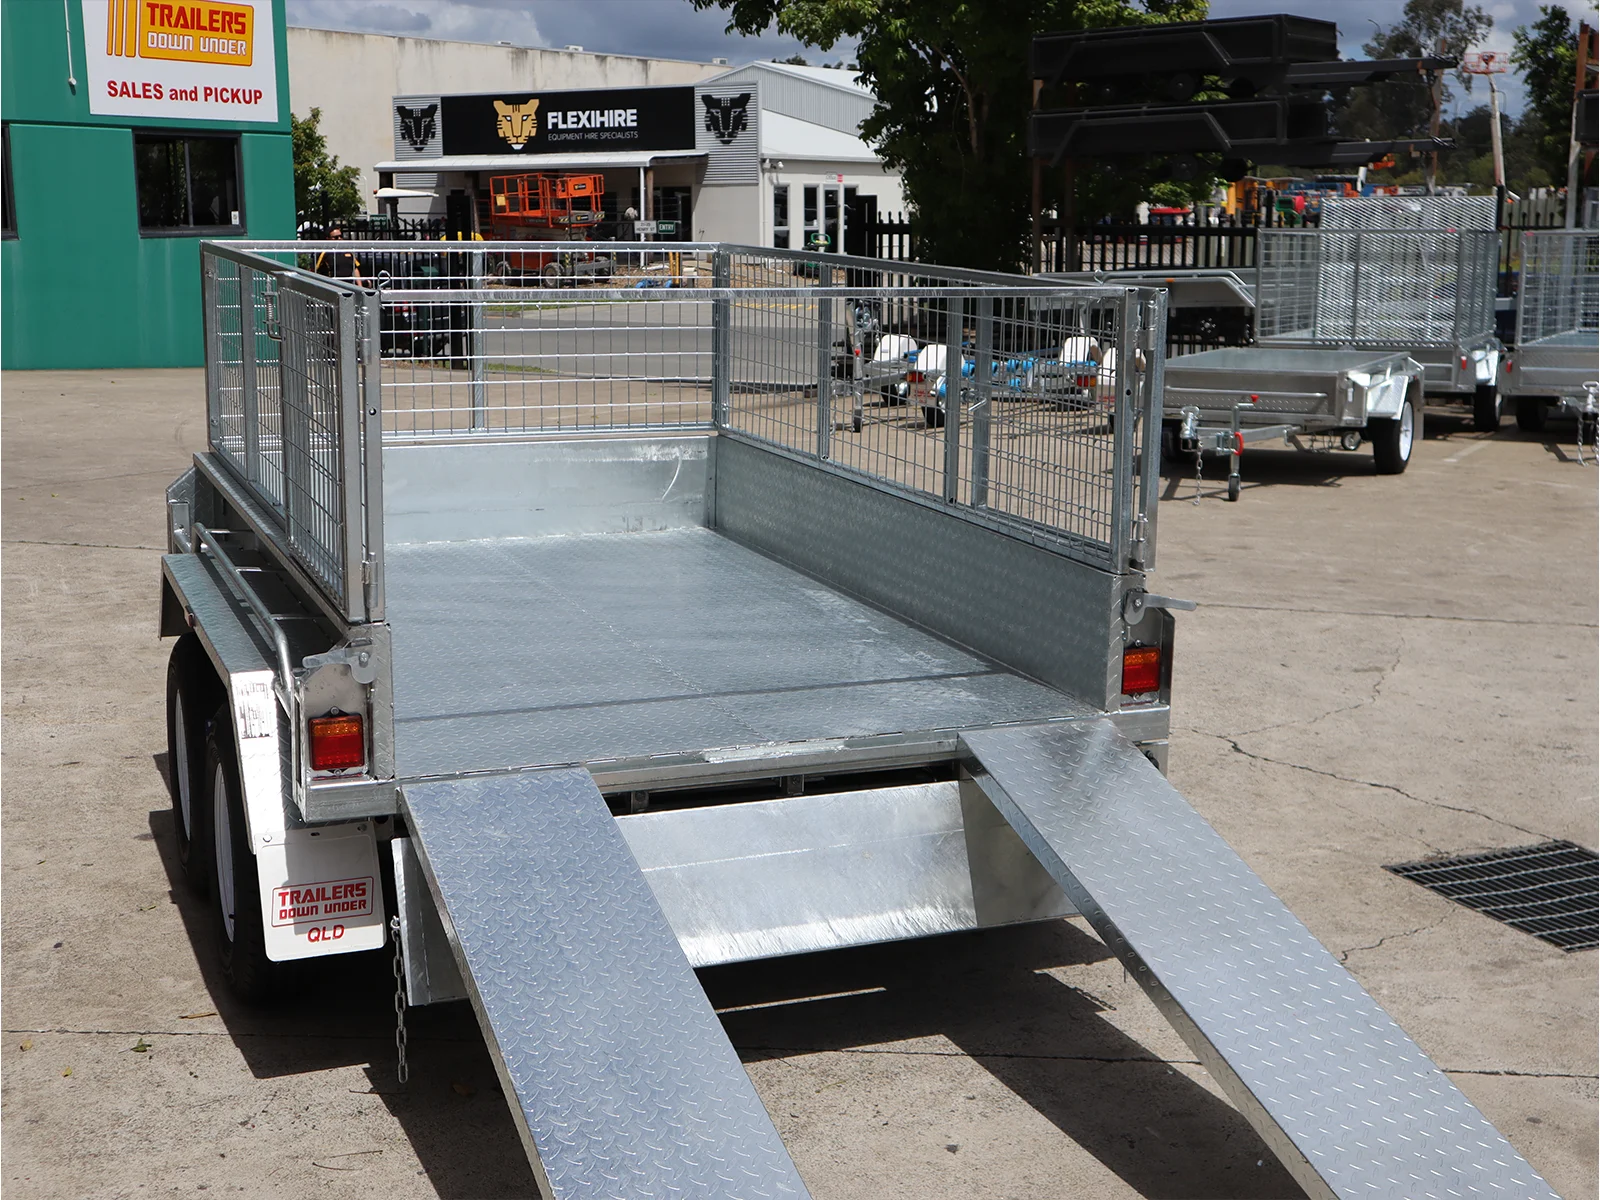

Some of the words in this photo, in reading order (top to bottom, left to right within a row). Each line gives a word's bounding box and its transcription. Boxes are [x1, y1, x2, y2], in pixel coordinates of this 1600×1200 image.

[146, 2, 247, 35] TRAILERS
[147, 31, 194, 51] DOWN
[200, 36, 247, 56] UNDER
[107, 80, 164, 100] SALES
[169, 86, 198, 102] and
[203, 86, 263, 105] PICKUP
[547, 109, 638, 129] FLEXIHIRE
[548, 132, 583, 141] EQUIPMENT
[584, 132, 599, 140] HIRE
[600, 131, 639, 139] SPECIALISTS
[659, 223, 674, 231] ENTRY
[278, 882, 367, 907] TRAILERS
[279, 905, 319, 920] DOWN
[324, 899, 367, 914] UNDER
[307, 924, 345, 943] QLD
